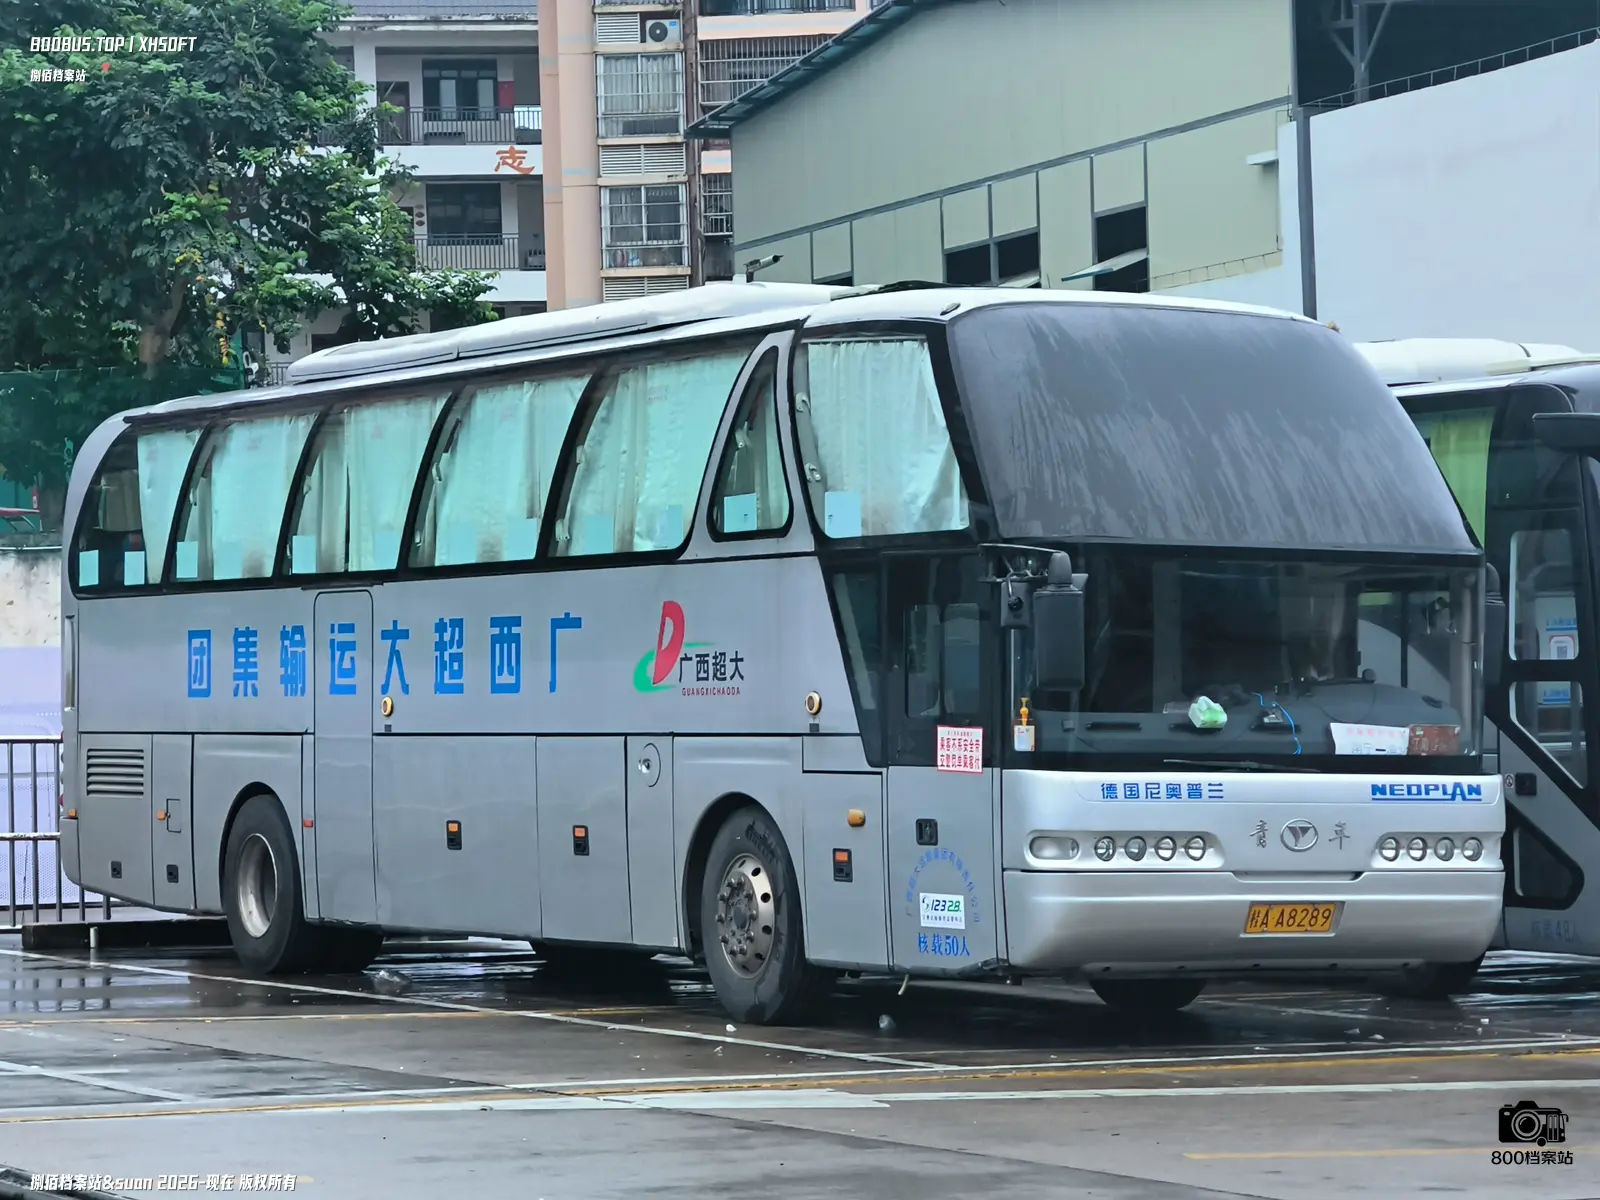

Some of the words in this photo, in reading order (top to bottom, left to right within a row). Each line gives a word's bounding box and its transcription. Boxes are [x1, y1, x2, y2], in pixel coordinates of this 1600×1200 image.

[494, 145, 536, 175] 志
[678, 650, 745, 683] 广西超大
[681, 686, 741, 697] GUANGXICHAODA
[1100, 782, 1224, 800] 德国尼奥普兰
[1370, 782, 1482, 801] NEOPLAN
[918, 931, 970, 957] 核载50人
